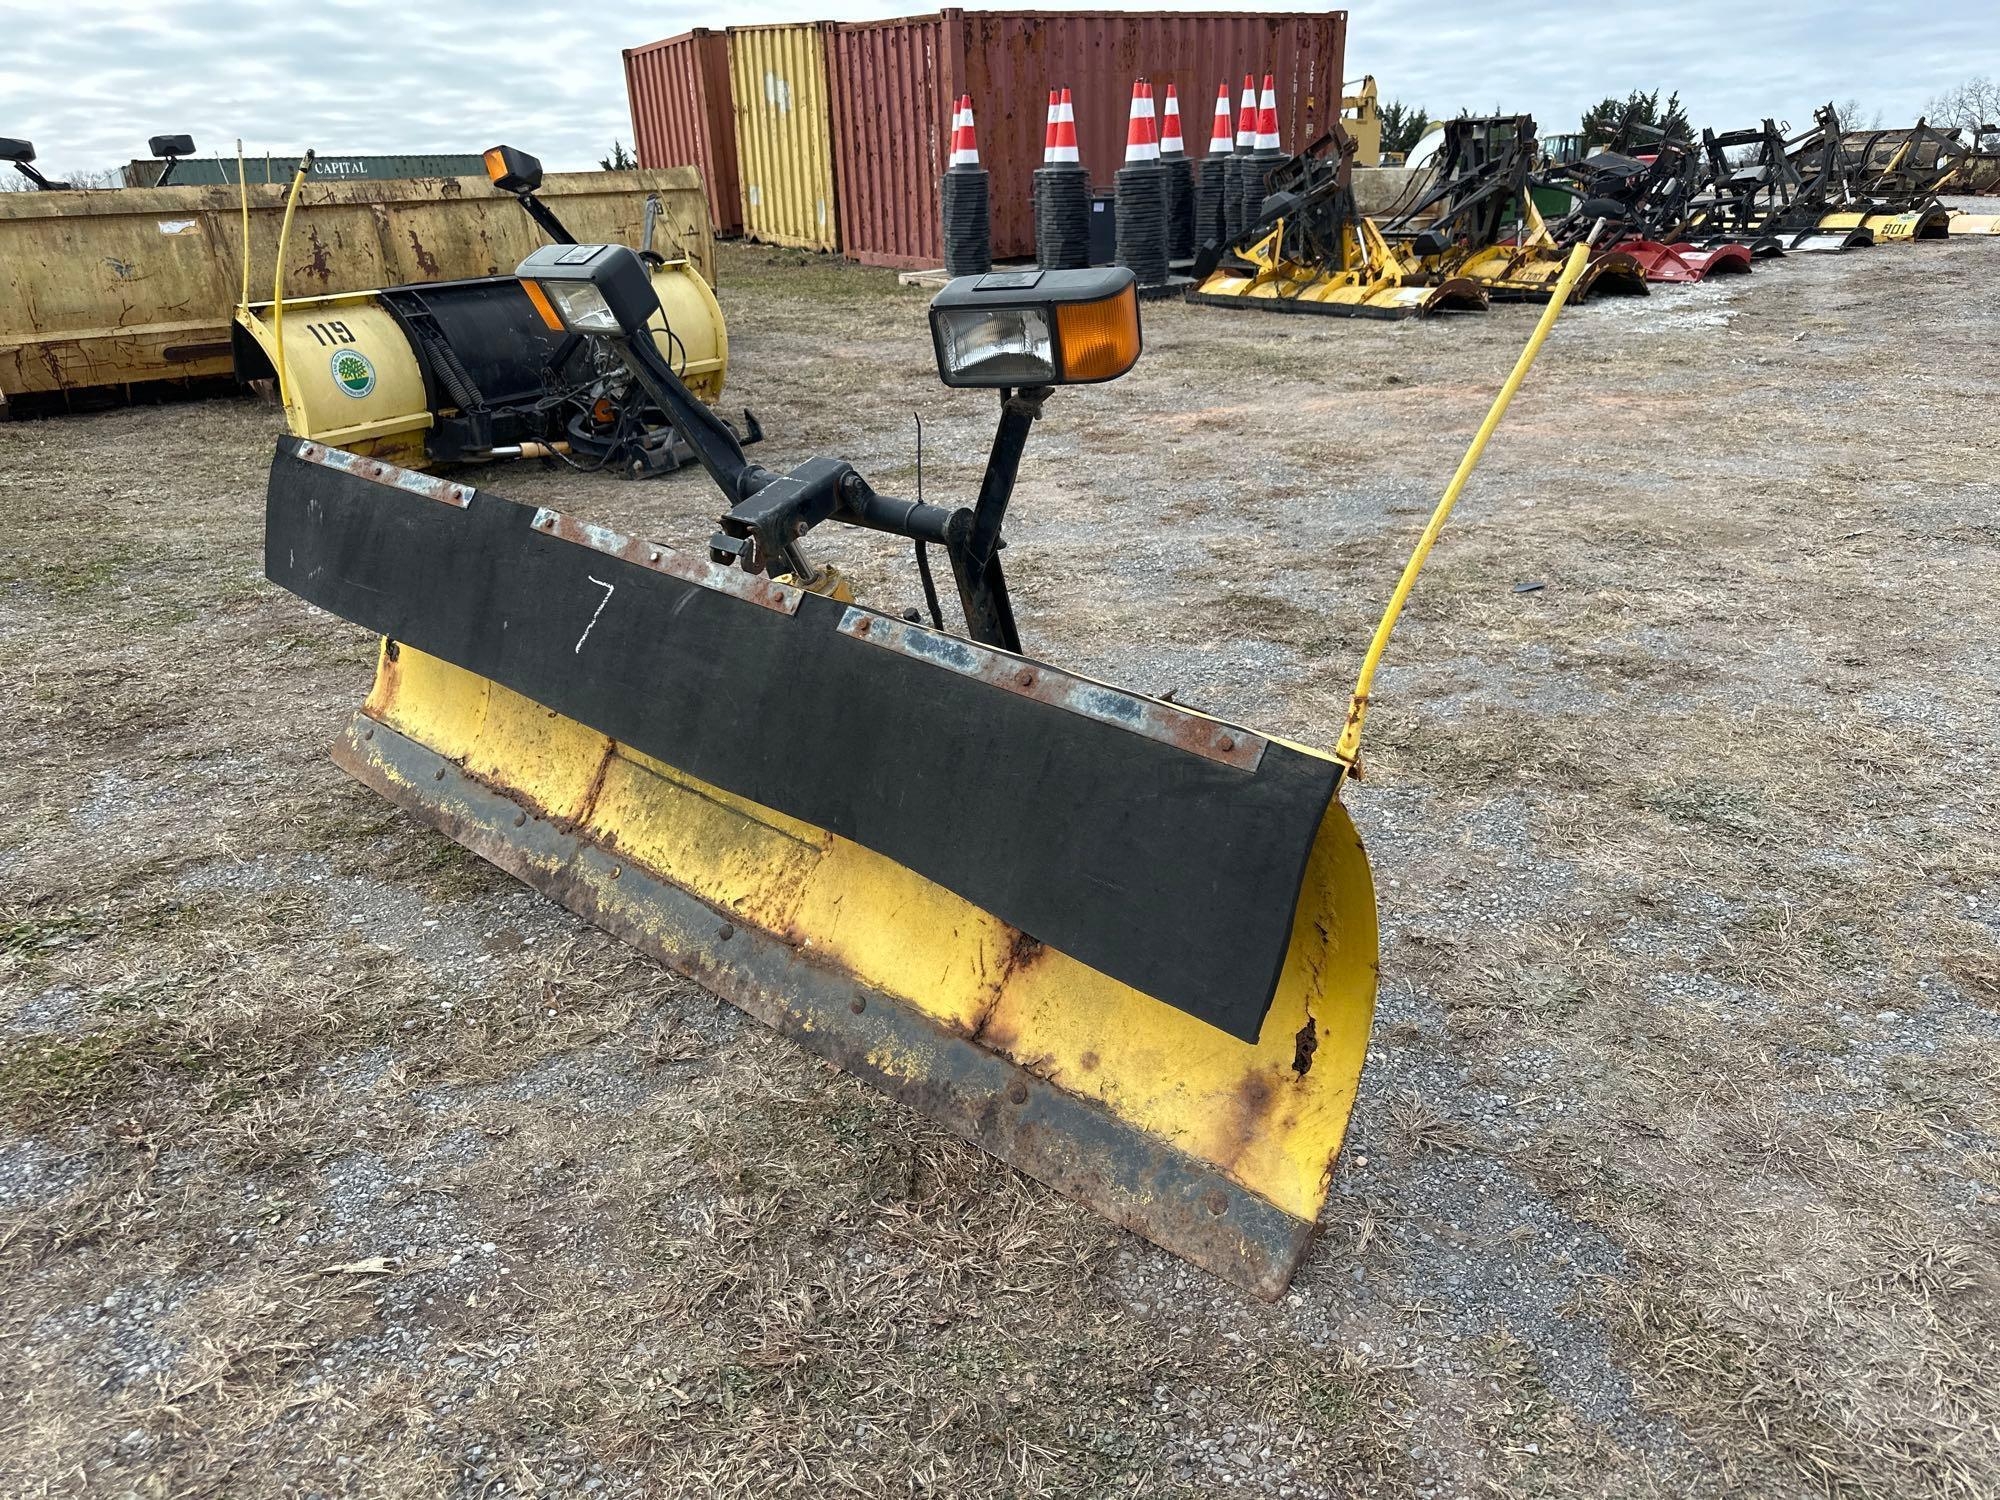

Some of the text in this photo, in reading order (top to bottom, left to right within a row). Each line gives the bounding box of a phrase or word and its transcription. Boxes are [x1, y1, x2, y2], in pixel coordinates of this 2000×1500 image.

[314, 161, 368, 174] CAPITAL
[306, 320, 356, 346] 119
[575, 574, 615, 654] 7
